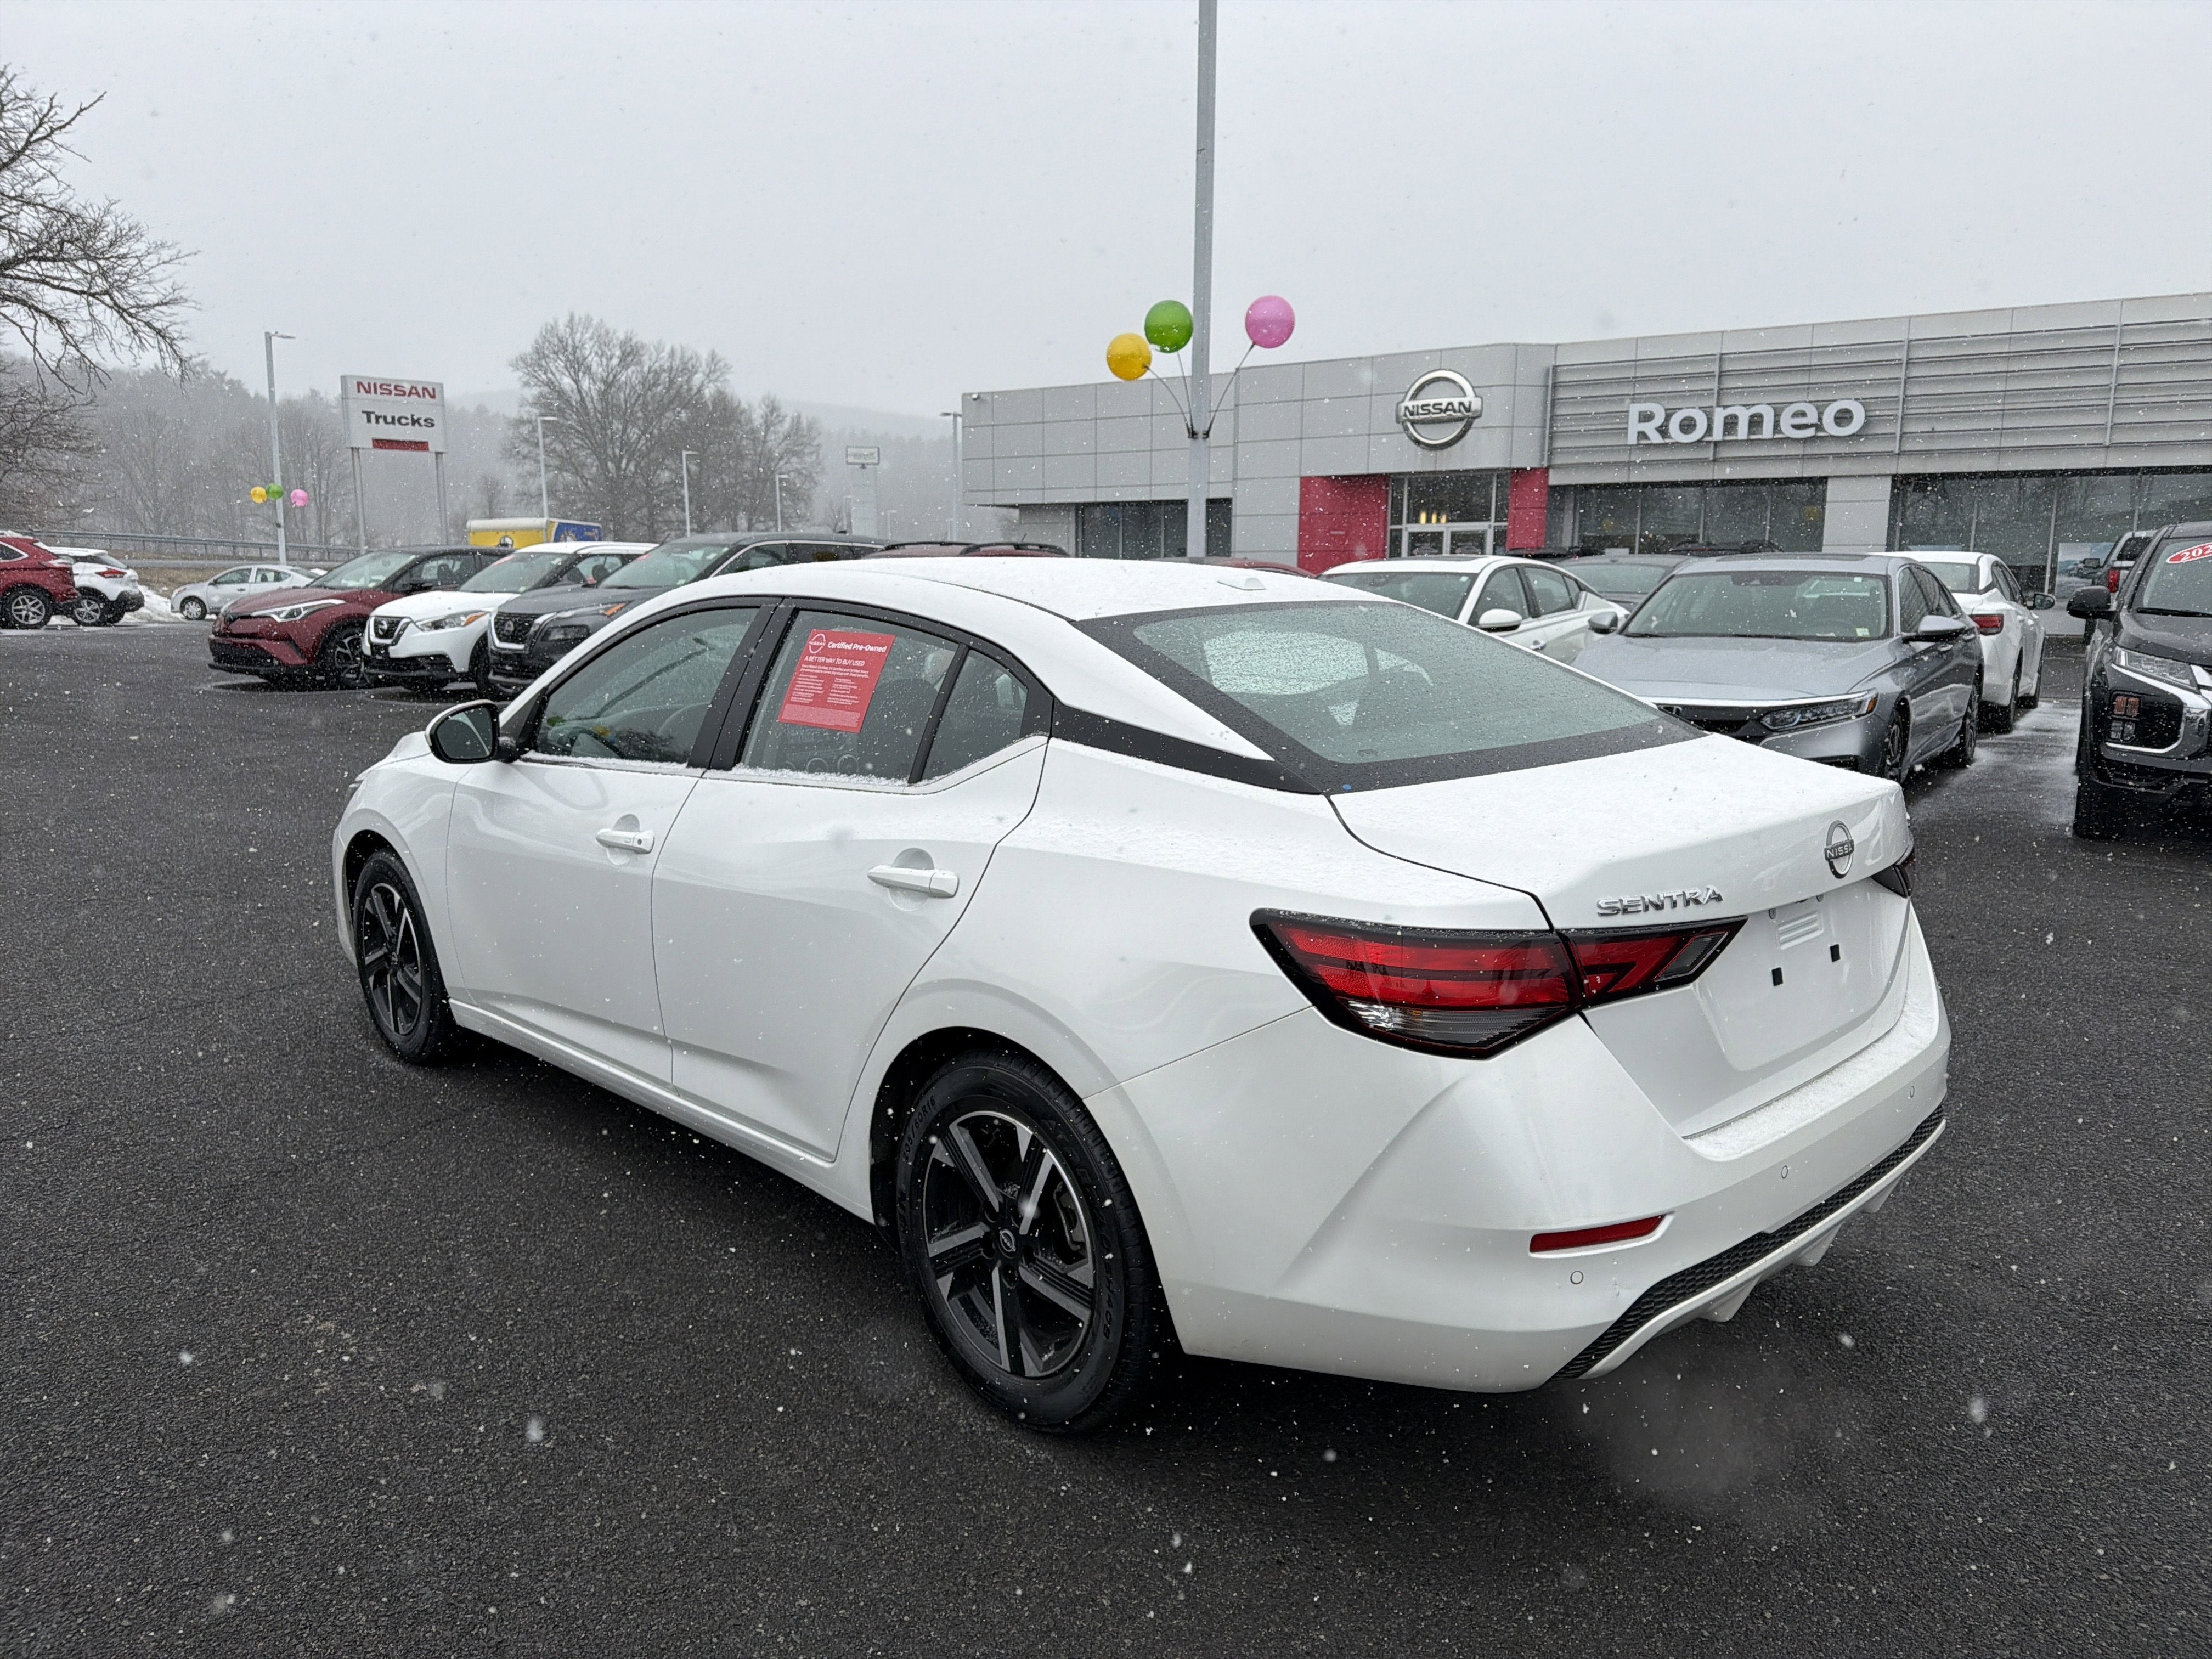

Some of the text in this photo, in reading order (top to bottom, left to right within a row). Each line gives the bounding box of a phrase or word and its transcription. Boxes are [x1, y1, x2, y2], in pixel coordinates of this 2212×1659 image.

[357, 381, 436, 400] NISSAN
[1404, 400, 1472, 417] NISSAN
[361, 410, 435, 428] Trucks
[1627, 399, 1865, 444] Romeo
[827, 641, 888, 653] Certified Pre-Owned
[1597, 885, 1723, 917] SENTRA
